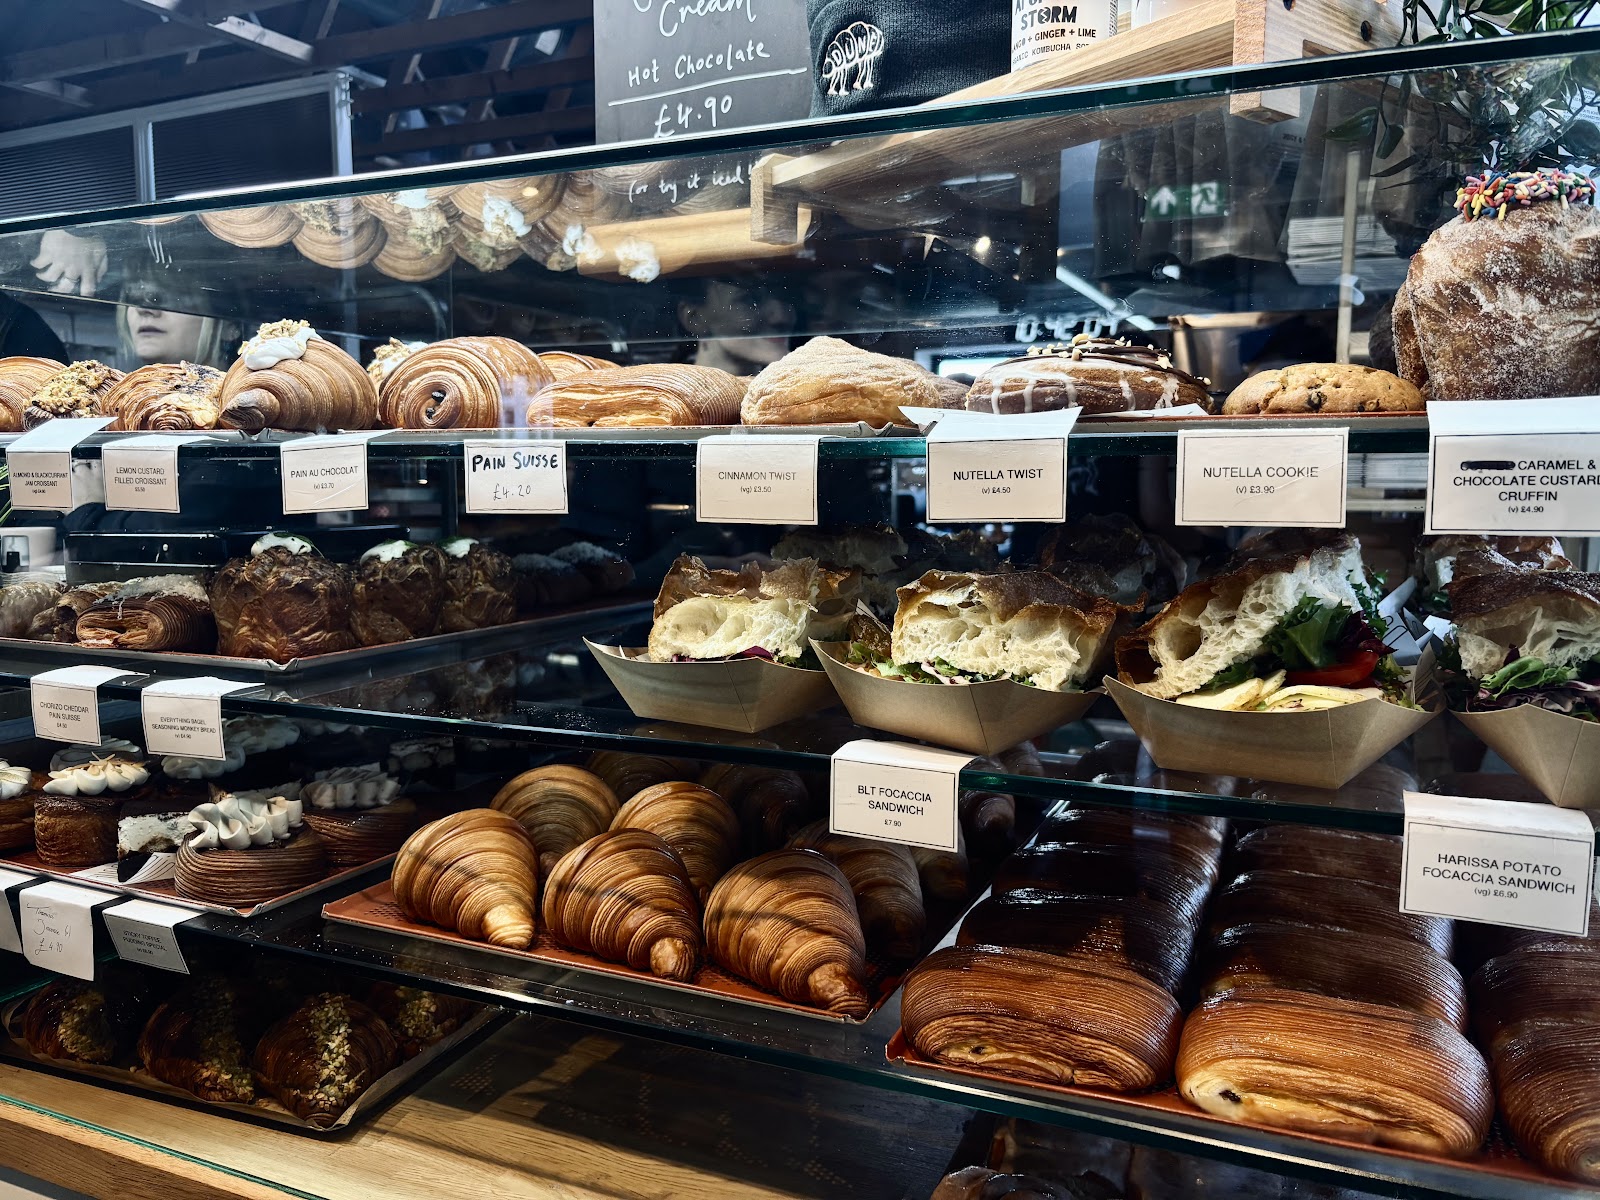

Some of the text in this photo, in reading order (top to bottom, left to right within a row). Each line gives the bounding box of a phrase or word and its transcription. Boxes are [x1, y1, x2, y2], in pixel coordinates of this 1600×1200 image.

[1020, 6, 1077, 31] STORM
[1011, 37, 1026, 53] ANGO
[1034, 28, 1065, 41] GINGER
[1078, 27, 1097, 38] LIME
[1031, 43, 1071, 56] KOMBUCHA
[628, 40, 771, 88] Hot Chocolate
[654, 95, 733, 139] £4.90
[628, 180, 649, 203] (or
[658, 178, 678, 204] try
[687, 173, 701, 189] it
[472, 451, 559, 473] PAIN SUISSE
[1517, 460, 1584, 471] CARAMEL
[1587, 459, 1597, 470] &
[116, 466, 165, 475] LEMON CUSTARD
[290, 465, 359, 478] PAIN AU CHOCOLAT
[718, 471, 797, 481] CINNAMON TWIST
[953, 468, 1044, 481] NUTELLA TWIST
[1203, 466, 1319, 478] NUTELLA COOKIE
[114, 476, 167, 486] FILLED CROISSANT
[1453, 476, 1537, 486] CHOCOLATE
[493, 482, 532, 501] £4.20
[740, 485, 772, 494] (vg) £3.50
[991, 486, 1011, 494] £4.50
[1235, 485, 1275, 494] (v) £3.90
[1498, 491, 1558, 502] CRUFFIN
[1508, 505, 1545, 513] (v) £4.90
[40, 701, 90, 714] CHORIZO CHEDDAR
[49, 711, 81, 722] PAIN SUISSE
[160, 716, 191, 724] EVERYTHING
[151, 723, 180, 731] SEASONING
[200, 726, 217, 734] BREAD
[857, 785, 932, 803] BLT FOCACCIA
[868, 800, 924, 816] SANDWICH
[884, 819, 902, 827] £7.90
[1437, 853, 1562, 877] HARISSA POTATO
[1422, 866, 1576, 895] FOCACCIA SANDWICH
[1474, 887, 1518, 899] (vg) £6.90
